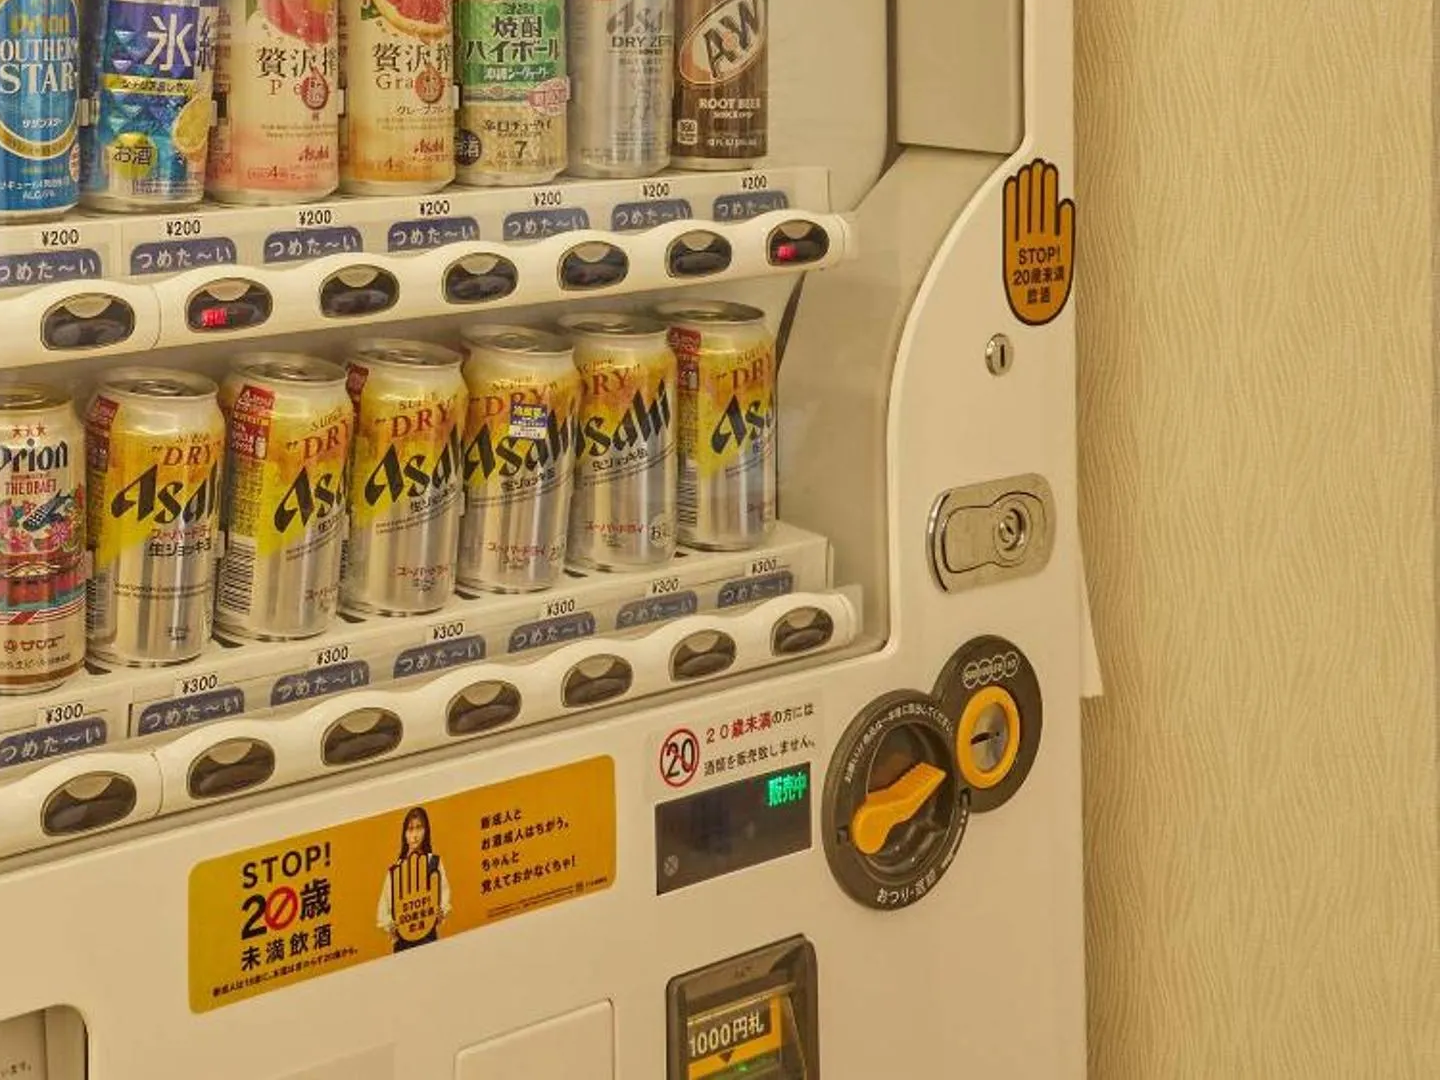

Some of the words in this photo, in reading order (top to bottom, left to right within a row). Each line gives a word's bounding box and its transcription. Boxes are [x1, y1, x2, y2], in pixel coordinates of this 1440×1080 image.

[492, 15, 543, 38] 焼酎
[465, 39, 560, 64] ハイボール
[611, 36, 647, 49] DRY
[0, 63, 75, 95] STAR
[699, 97, 736, 110] ROOT
[113, 145, 154, 166] お酒
[641, 182, 671, 198] ¥200
[741, 174, 768, 190] ¥200
[418, 199, 450, 216] ¥200
[532, 190, 562, 207] ¥200
[298, 209, 332, 226] ¥200
[40, 228, 80, 246] ¥200
[165, 219, 202, 237] ¥200
[1018, 245, 1062, 265] STOP!
[4, 481, 24, 495] THE
[25, 478, 57, 495] DRAFT
[546, 599, 576, 617] ¥300
[432, 621, 465, 640] ¥300
[316, 645, 350, 666] ¥300
[180, 673, 219, 694] ¥300
[44, 702, 85, 723] ¥300
[769, 772, 808, 808] 販売中
[242, 841, 332, 889] STOP!
[480, 850, 520, 872] ちゃんと
[403, 894, 433, 911] STOP!
[241, 923, 333, 972] 未満飲酒
[688, 1009, 766, 1058] 1000円札
